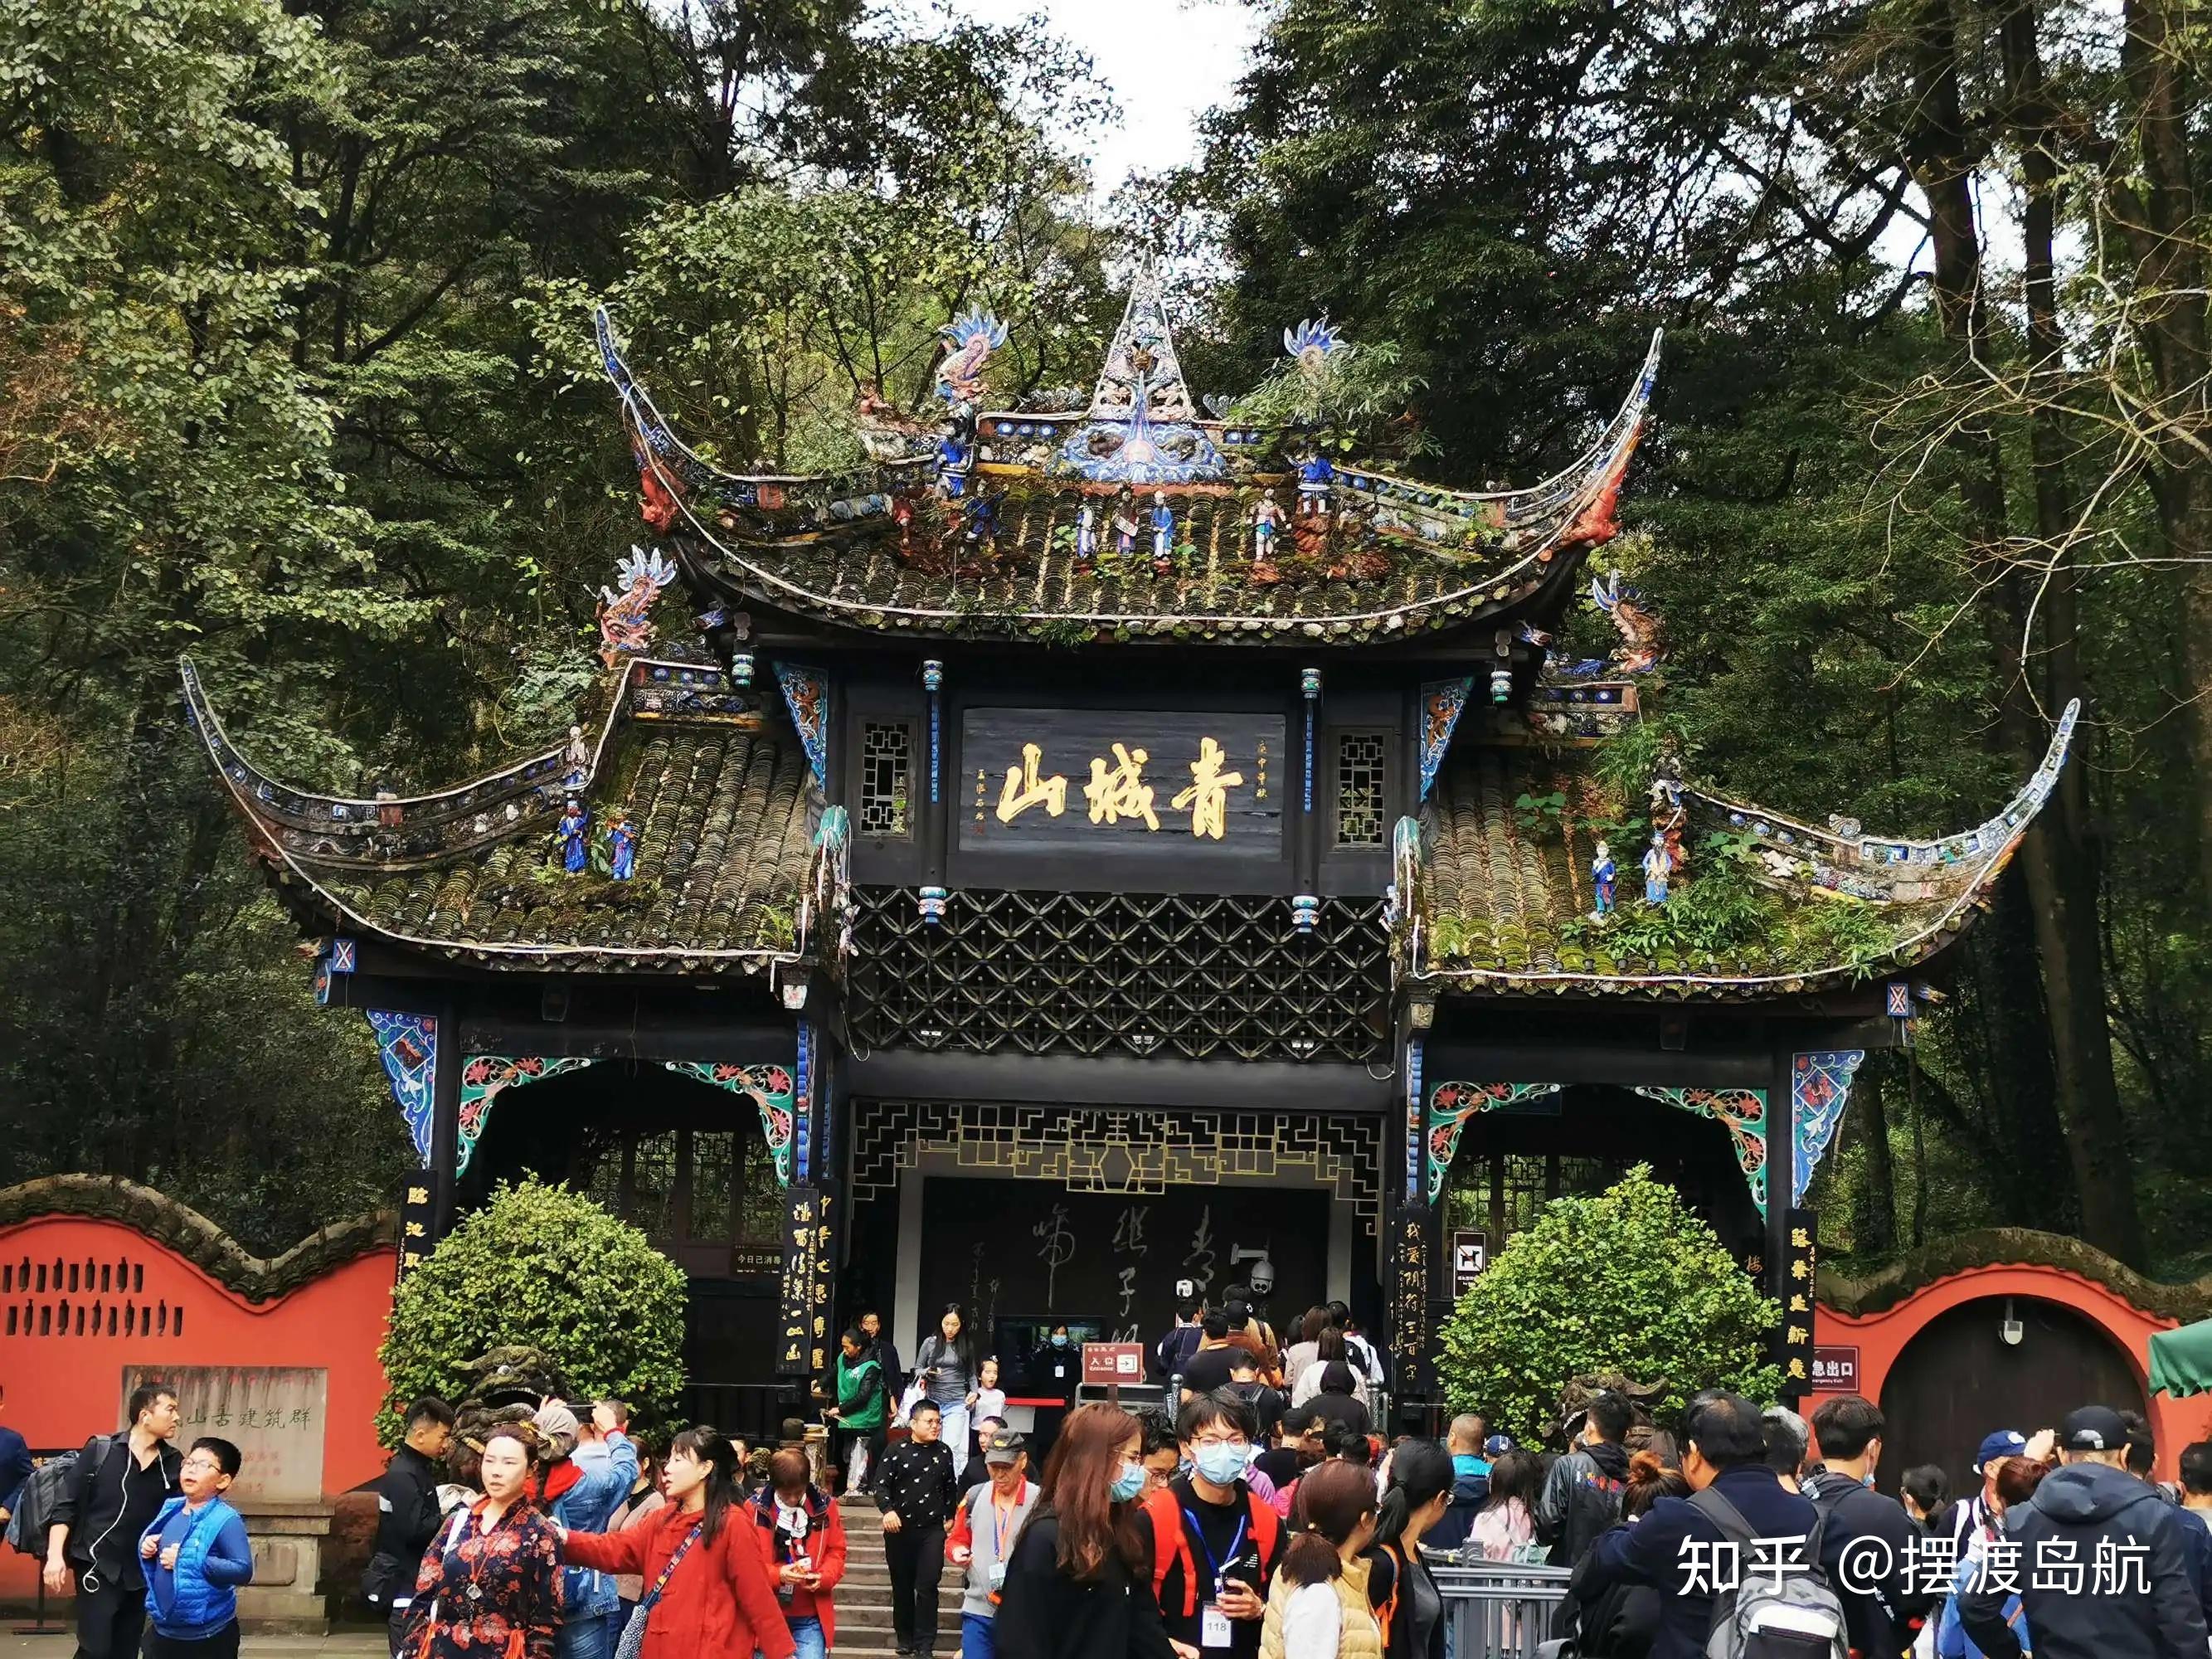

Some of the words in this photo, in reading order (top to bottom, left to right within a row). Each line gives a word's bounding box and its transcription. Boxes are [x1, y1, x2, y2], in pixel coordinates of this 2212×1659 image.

[997, 737, 1243, 840] 青城山
[1091, 1356, 1113, 1366] 入口
[176, 1408, 311, 1431] 山古建筑群
[1207, 1623, 1227, 1632] 118
